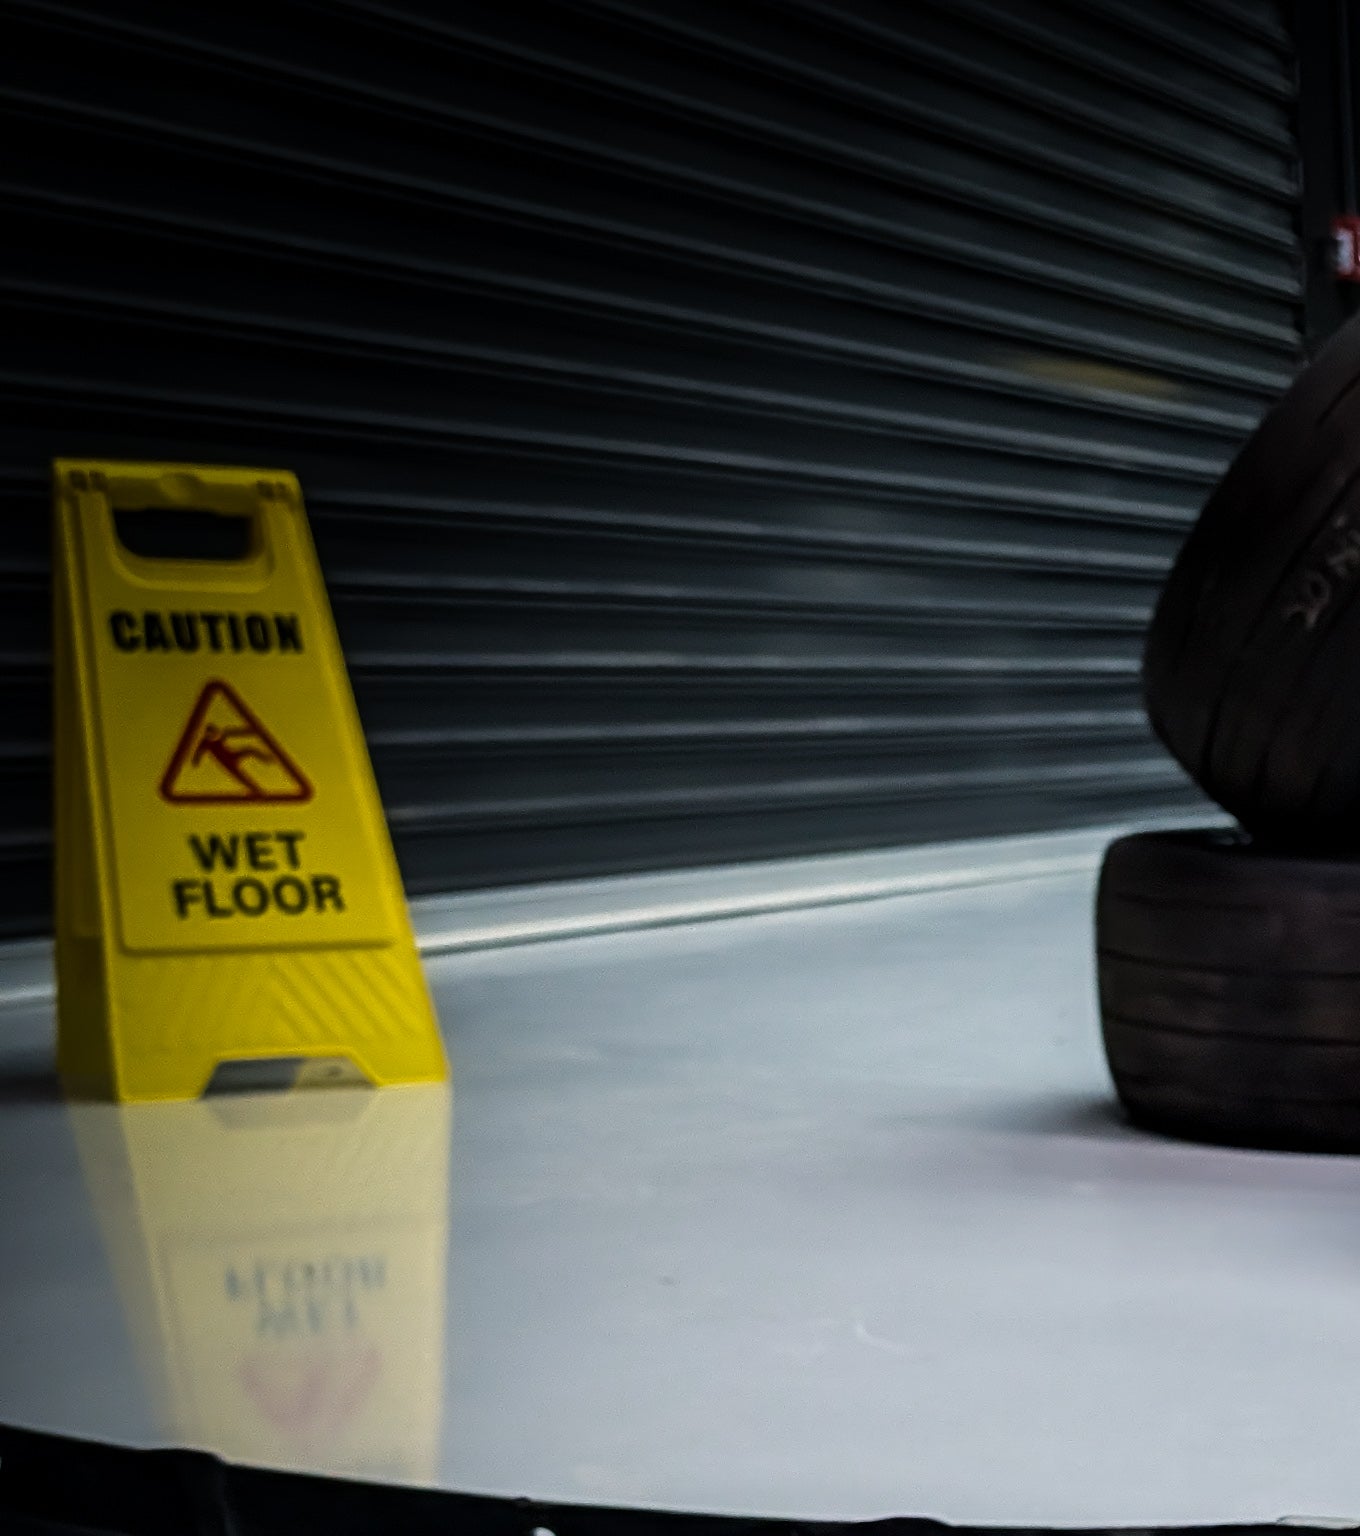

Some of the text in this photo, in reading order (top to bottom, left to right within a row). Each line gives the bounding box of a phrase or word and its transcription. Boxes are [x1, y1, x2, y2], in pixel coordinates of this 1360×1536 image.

[110, 611, 301, 653] CAUTION
[190, 831, 305, 871] WET
[174, 875, 346, 919] FLOOR
